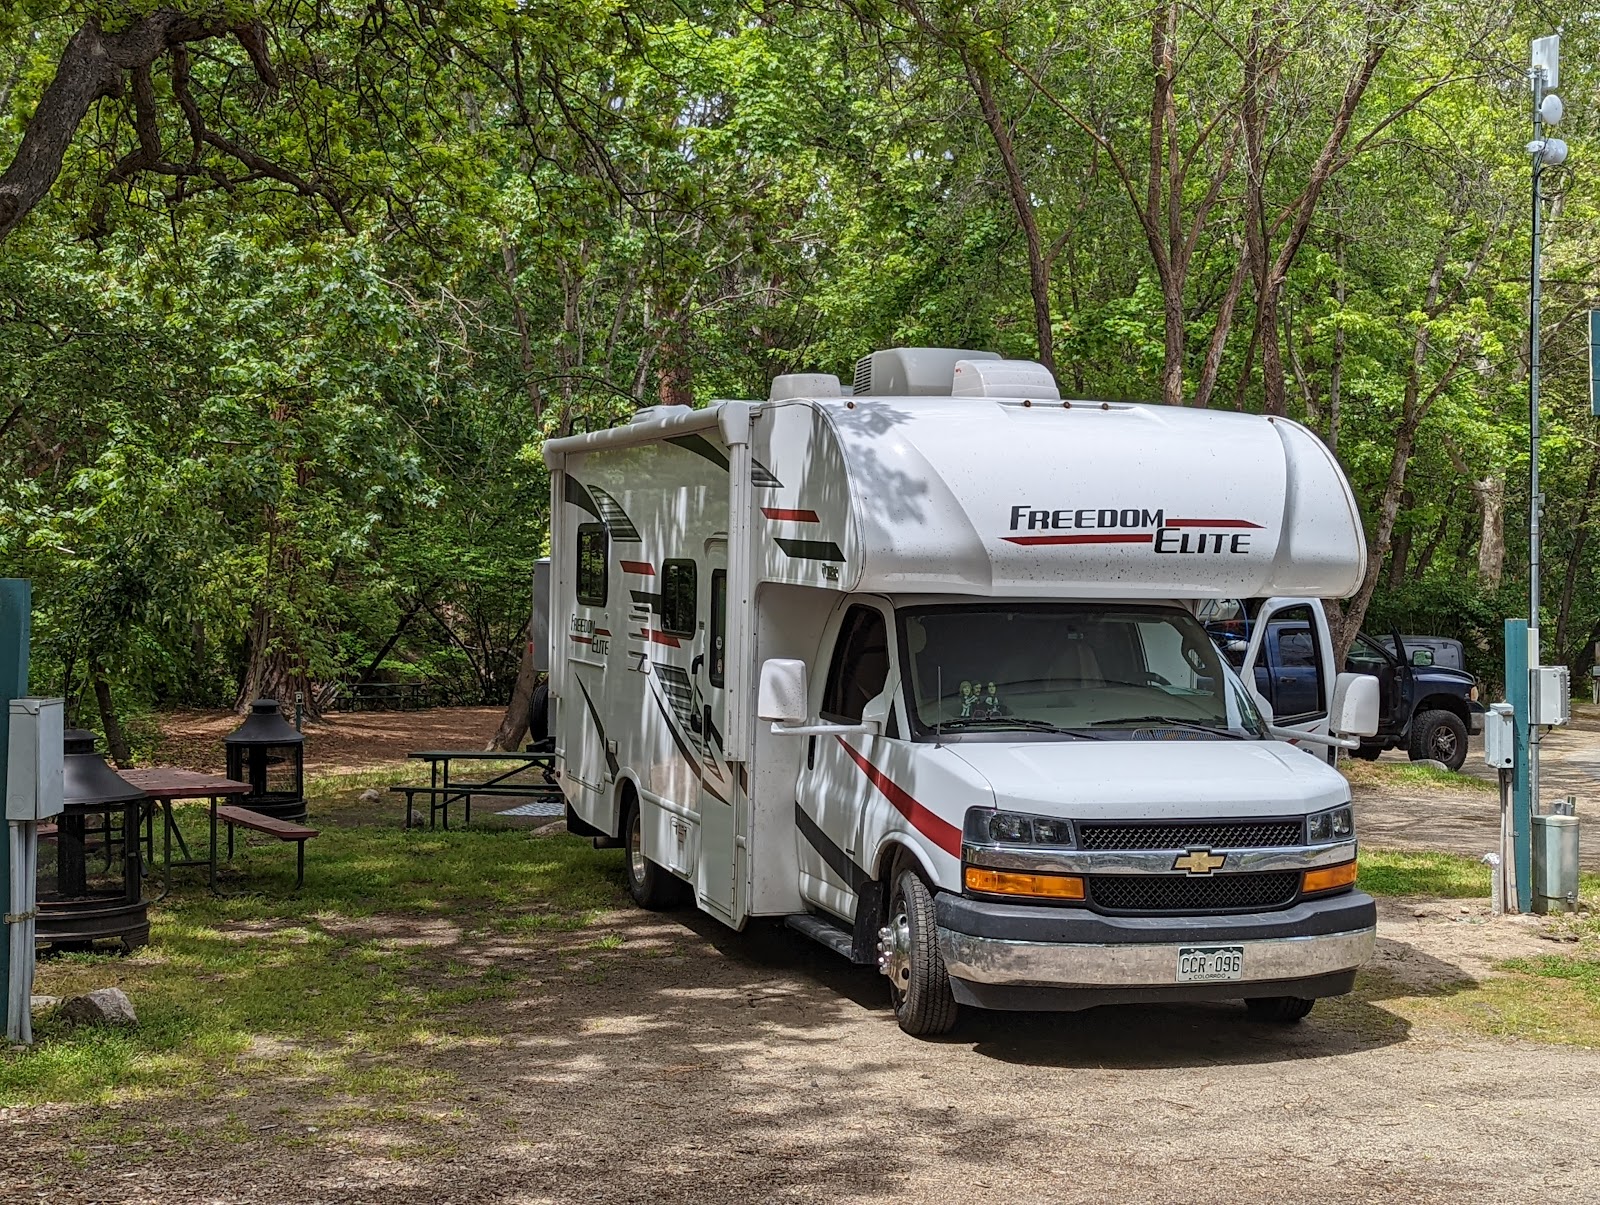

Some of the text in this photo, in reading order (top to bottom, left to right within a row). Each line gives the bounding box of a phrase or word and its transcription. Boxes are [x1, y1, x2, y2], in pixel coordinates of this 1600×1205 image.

[1009, 505, 1164, 530] FREEDOM
[1154, 528, 1251, 554] ELITE
[592, 635, 609, 655] ELITE
